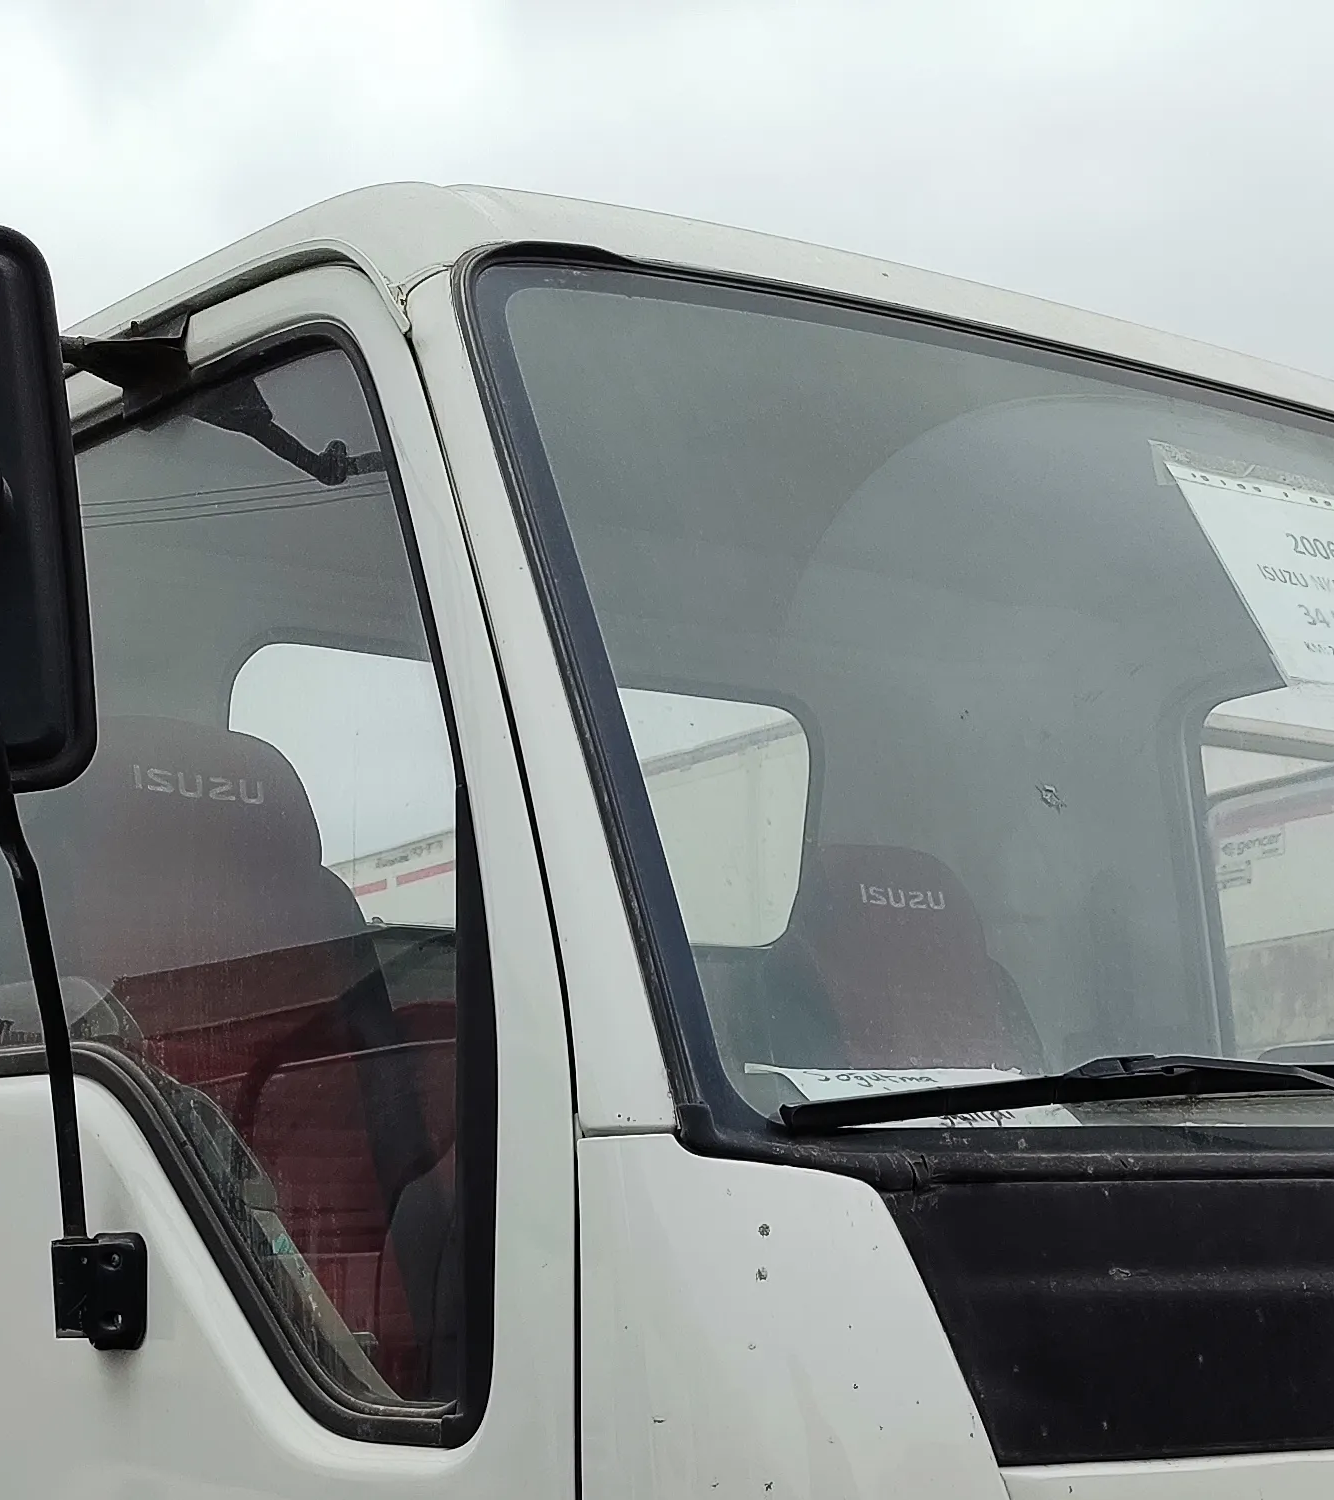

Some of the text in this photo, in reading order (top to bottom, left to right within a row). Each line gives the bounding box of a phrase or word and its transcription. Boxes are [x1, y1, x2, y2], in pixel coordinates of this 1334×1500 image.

[1256, 563, 1309, 588] ISUZU
[1297, 604, 1331, 629] 34
[133, 764, 264, 804] ISUZU
[860, 884, 946, 910] ISUZU
